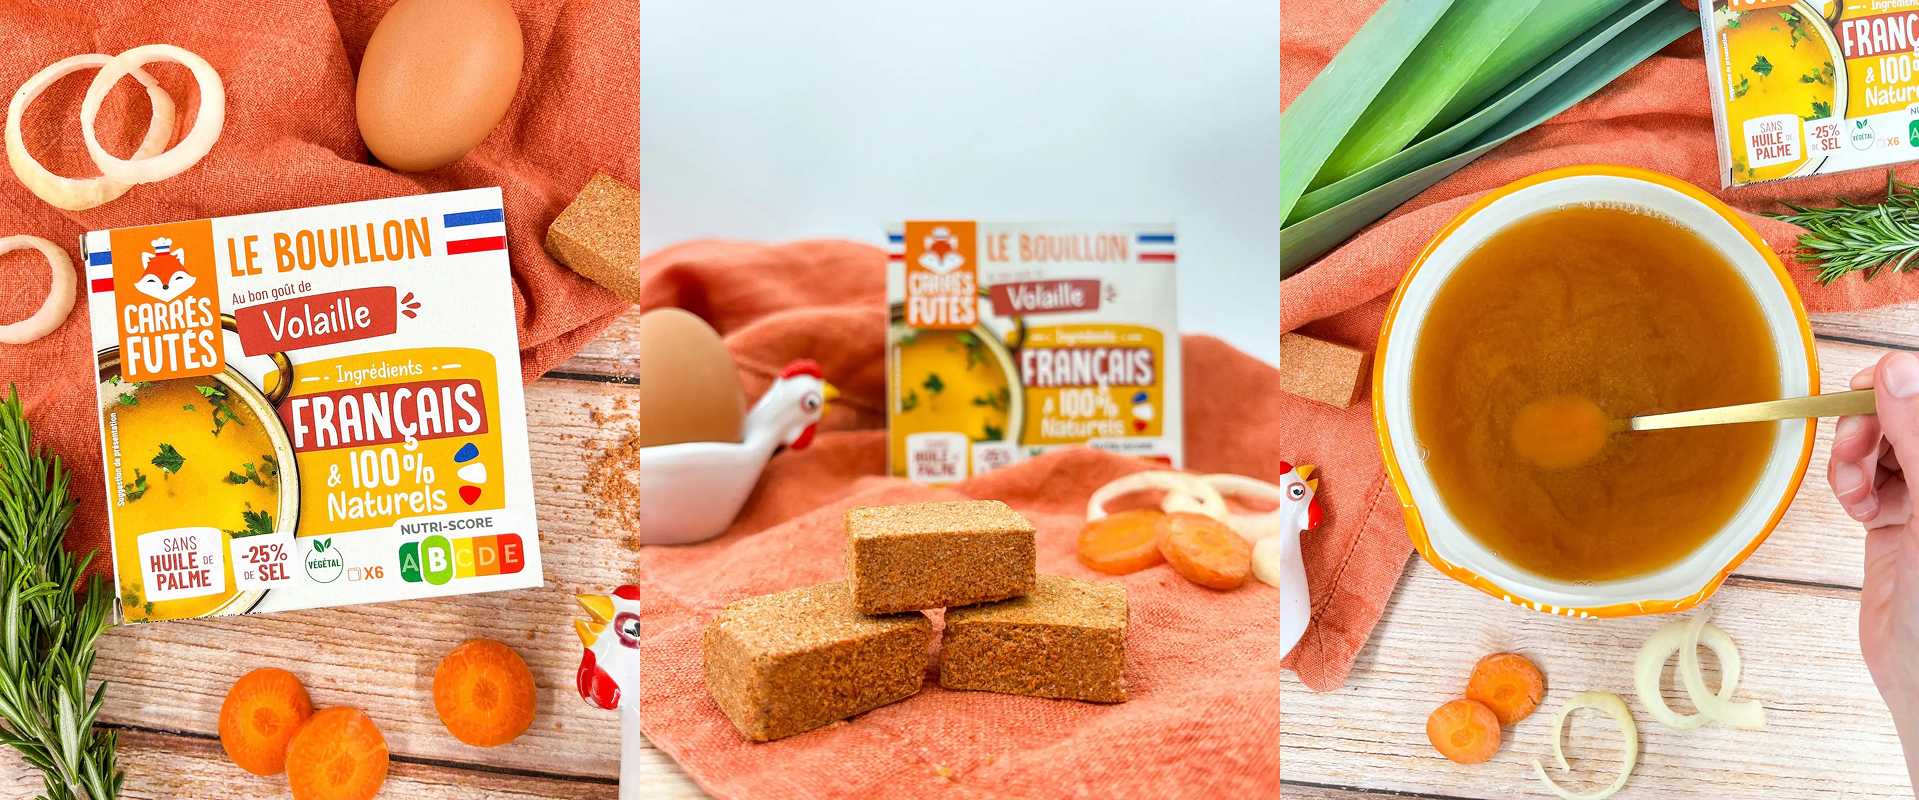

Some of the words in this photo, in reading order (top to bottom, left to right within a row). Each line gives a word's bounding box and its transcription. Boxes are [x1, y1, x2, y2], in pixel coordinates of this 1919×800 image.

[1865, 67, 1875, 84] &
[1759, 121, 1783, 134] SANS
[1811, 124, 1840, 139] -25%
[1752, 131, 1784, 148] HUILE
[1822, 138, 1841, 151] SEL
[1887, 136, 1900, 147] X6
[1756, 144, 1792, 161] PALME
[227, 235, 263, 277] LE
[273, 217, 432, 273] BOUILLON
[986, 234, 1010, 263] LE
[1018, 234, 1129, 263] BOUILLON
[232, 293, 246, 305] Au
[248, 290, 269, 302] bon
[271, 283, 296, 301] goût
[298, 281, 312, 292] de
[1006, 281, 1087, 311] Volaille
[124, 295, 214, 334] CARRÉS
[262, 297, 371, 342] Volaille
[126, 329, 217, 376] FUTÉS
[336, 359, 423, 386] Ingrédients
[1022, 347, 1153, 393] FRANÇAIS
[291, 383, 481, 451] FRANÇAIS
[113, 458, 121, 467] de
[327, 464, 342, 487] &
[350, 447, 435, 489] 100%
[115, 468, 126, 507] Suggestion
[327, 485, 448, 522] Naturels
[400, 517, 494, 535] NUTRI-SCORE
[163, 535, 197, 553] SANS
[241, 543, 288, 564] -25%
[150, 552, 198, 573] HUILE
[202, 554, 214, 566] DE
[244, 570, 255, 581] DE
[258, 562, 290, 582] SEL
[308, 558, 341, 570] VÉGÉTAL
[364, 566, 384, 580] X6
[156, 569, 212, 591] PALME
